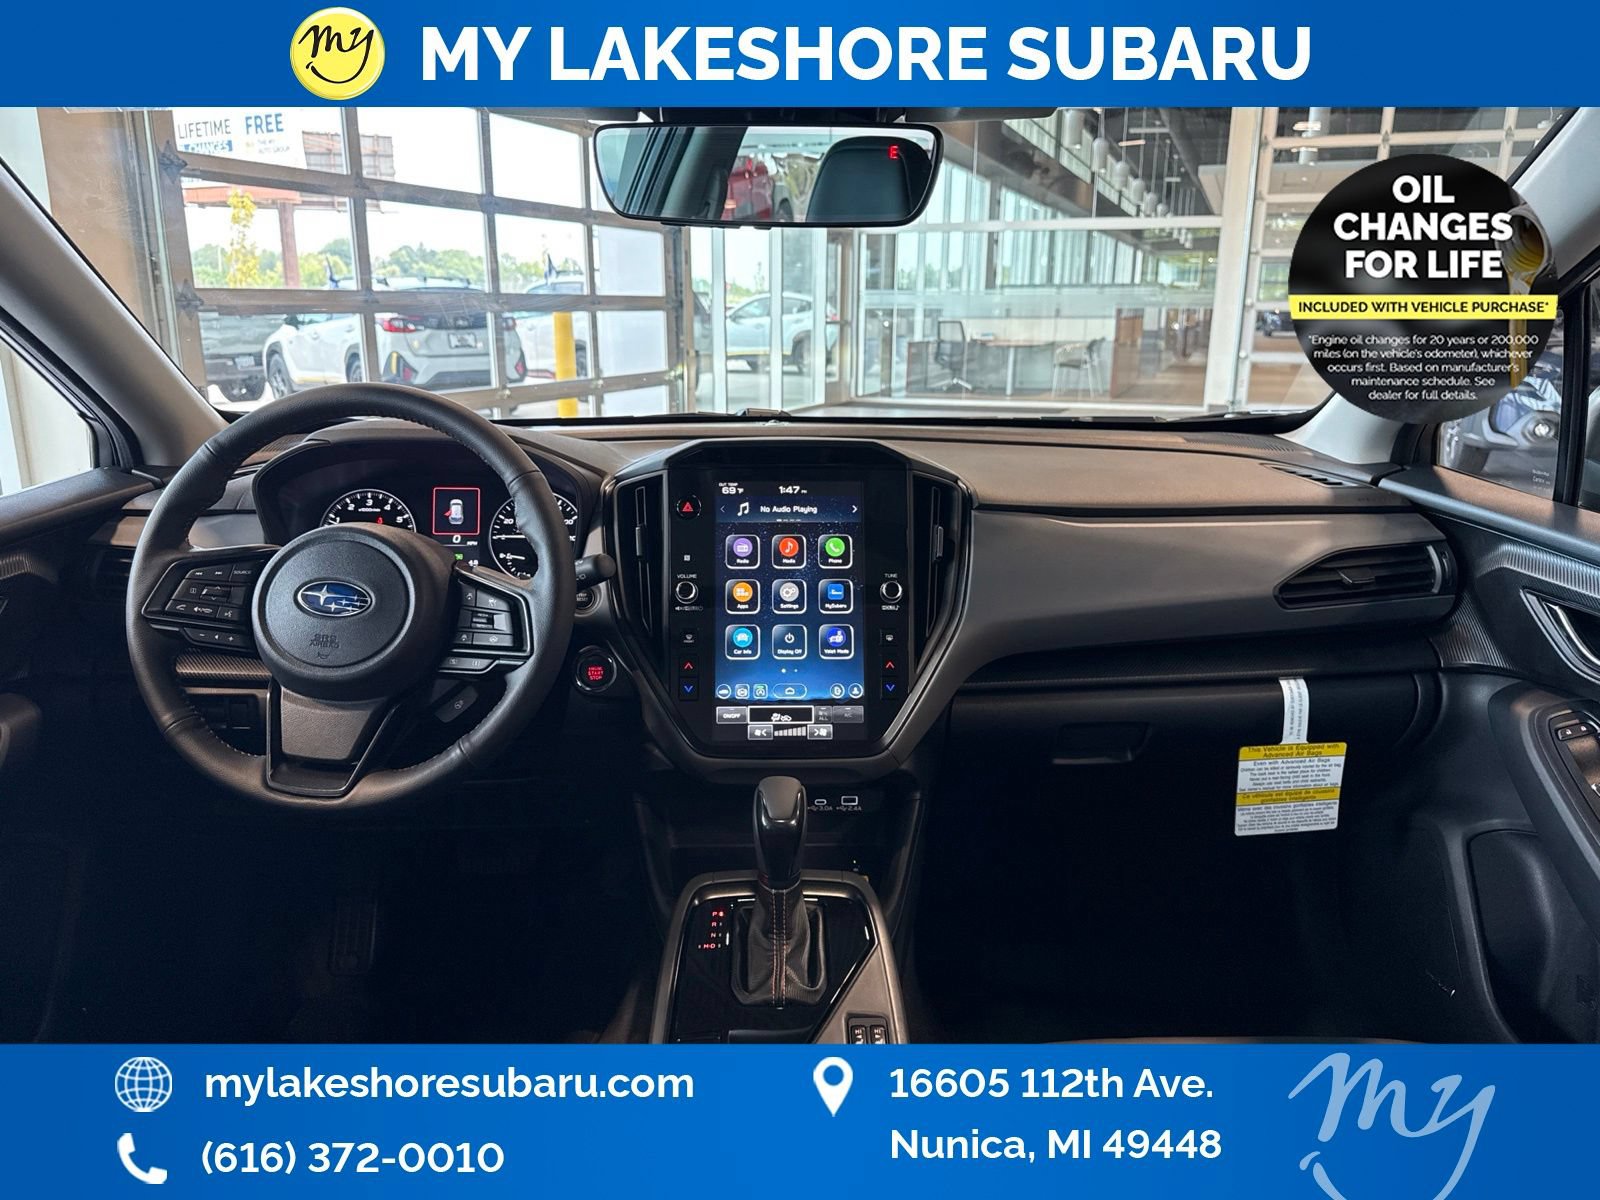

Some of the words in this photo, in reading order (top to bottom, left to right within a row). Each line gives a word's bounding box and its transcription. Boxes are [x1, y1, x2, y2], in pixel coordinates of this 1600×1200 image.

[245, 112, 284, 135] FREE
[178, 119, 232, 139] LIFETIME
[778, 486, 800, 494] 1:47
[793, 505, 818, 514] Playing
[452, 534, 462, 544] 0
